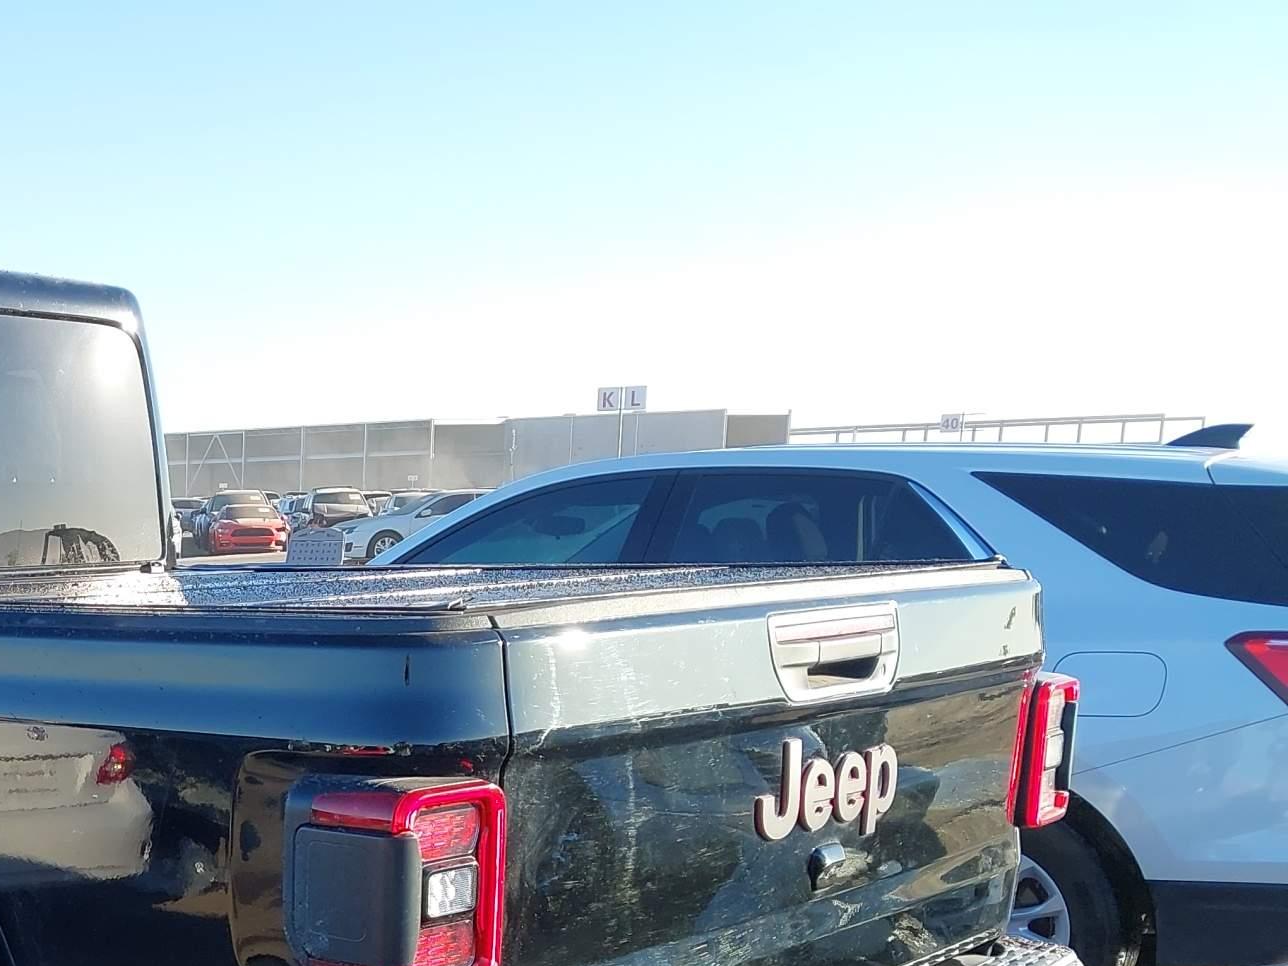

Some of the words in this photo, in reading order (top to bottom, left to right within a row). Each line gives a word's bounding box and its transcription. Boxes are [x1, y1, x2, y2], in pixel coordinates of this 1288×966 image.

[602, 391, 615, 408] K
[631, 390, 641, 407] L
[942, 417, 959, 429] 40
[753, 736, 898, 842] Jeep
